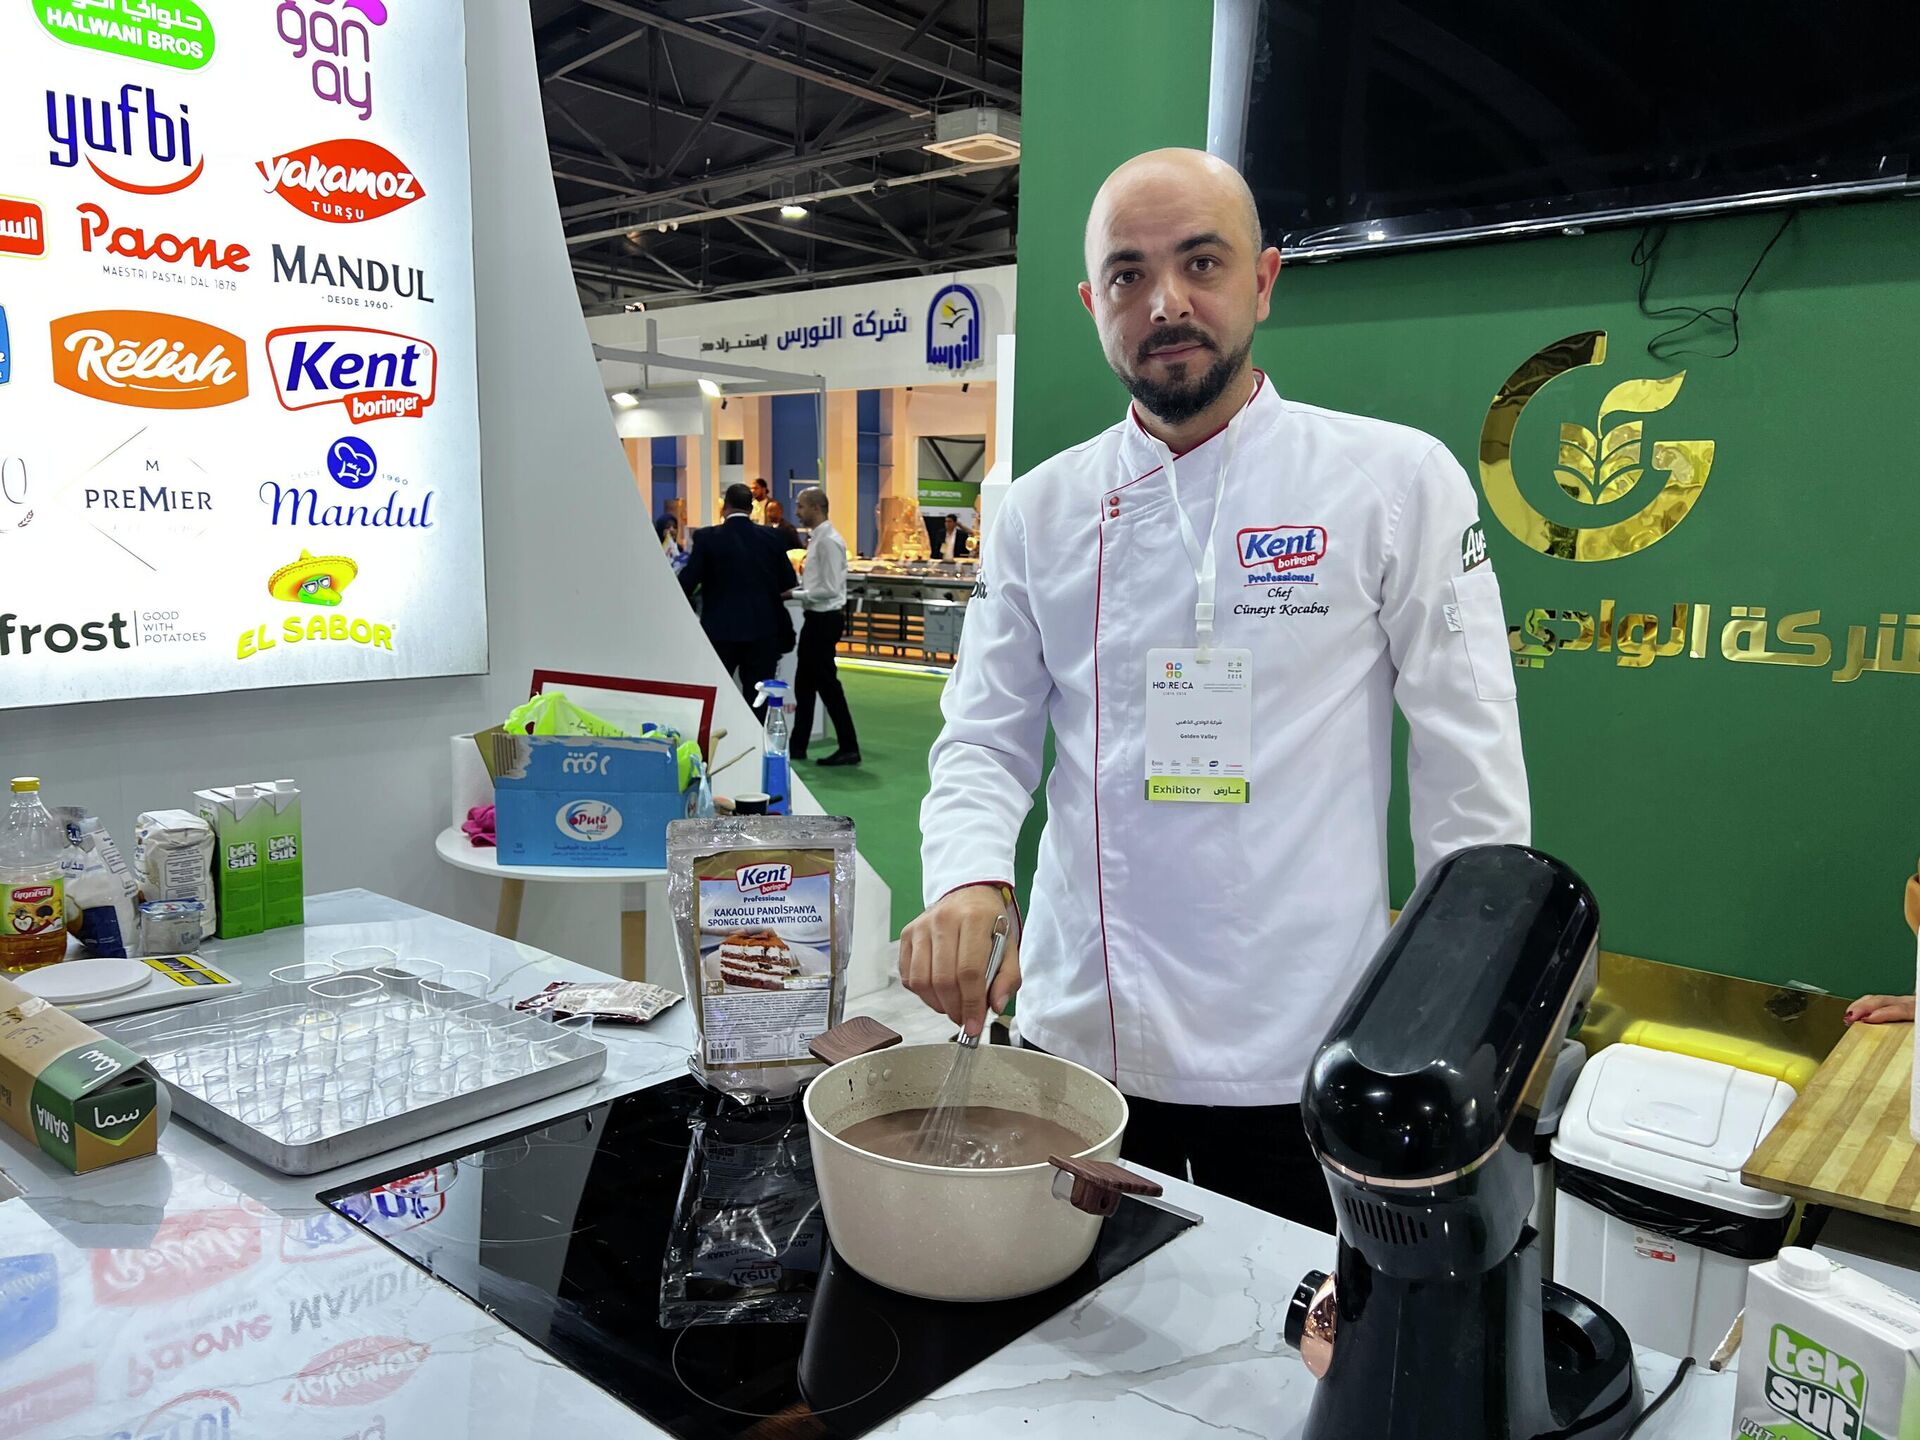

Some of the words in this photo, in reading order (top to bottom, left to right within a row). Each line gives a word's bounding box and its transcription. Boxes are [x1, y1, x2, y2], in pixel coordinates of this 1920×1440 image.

[46, 7, 142, 45] HALWANI
[147, 29, 203, 59] BROS
[46, 83, 192, 168] yufbi
[255, 154, 416, 200] yakamoz
[311, 200, 365, 220] TURŞU
[76, 202, 251, 273] Paone
[103, 265, 147, 279] MAESTRI
[152, 271, 187, 285] PASTAI
[190, 275, 210, 288] DAL
[215, 279, 237, 292] 1878
[272, 243, 434, 304] MANDUL
[327, 294, 360, 306] DESDE
[364, 299, 389, 310] 1960
[777, 315, 842, 351] النورس
[852, 307, 907, 342] شركة
[286, 342, 421, 391] Kent
[352, 394, 419, 418] boringer
[382, 473, 409, 486] 1960
[84, 486, 213, 512] PREMIER
[259, 481, 435, 528] Mandul
[1245, 529, 1317, 560] Kent
[1248, 572, 1314, 584] Professional
[1267, 587, 1294, 601] Chef
[142, 611, 180, 622] GOOD
[1233, 604, 1276, 618] Cüneyt
[1279, 602, 1330, 616] Kocabaş
[143, 623, 174, 632] WITH
[144, 632, 207, 644] POTATOES
[237, 623, 276, 660] EL
[283, 613, 393, 651] SABOR
[1153, 785, 1201, 795] Exhibitor
[578, 813, 607, 826] Pure
[229, 842, 256, 858] tek
[269, 835, 296, 851] tek
[741, 866, 787, 887] Kent
[708, 918, 739, 927] SPONGE
[740, 917, 760, 926] CAKE
[761, 916, 777, 925] MIX
[777, 916, 796, 924] WITH
[797, 915, 823, 923] COCOA
[714, 907, 755, 917] KAKAOLU
[757, 905, 816, 916] PANDİSPANYA
[36, 1103, 70, 1144] SAMA
[94, 1107, 140, 1129] سما
[1775, 1328, 1859, 1402] tek
[1770, 1375, 1855, 1440] süt
